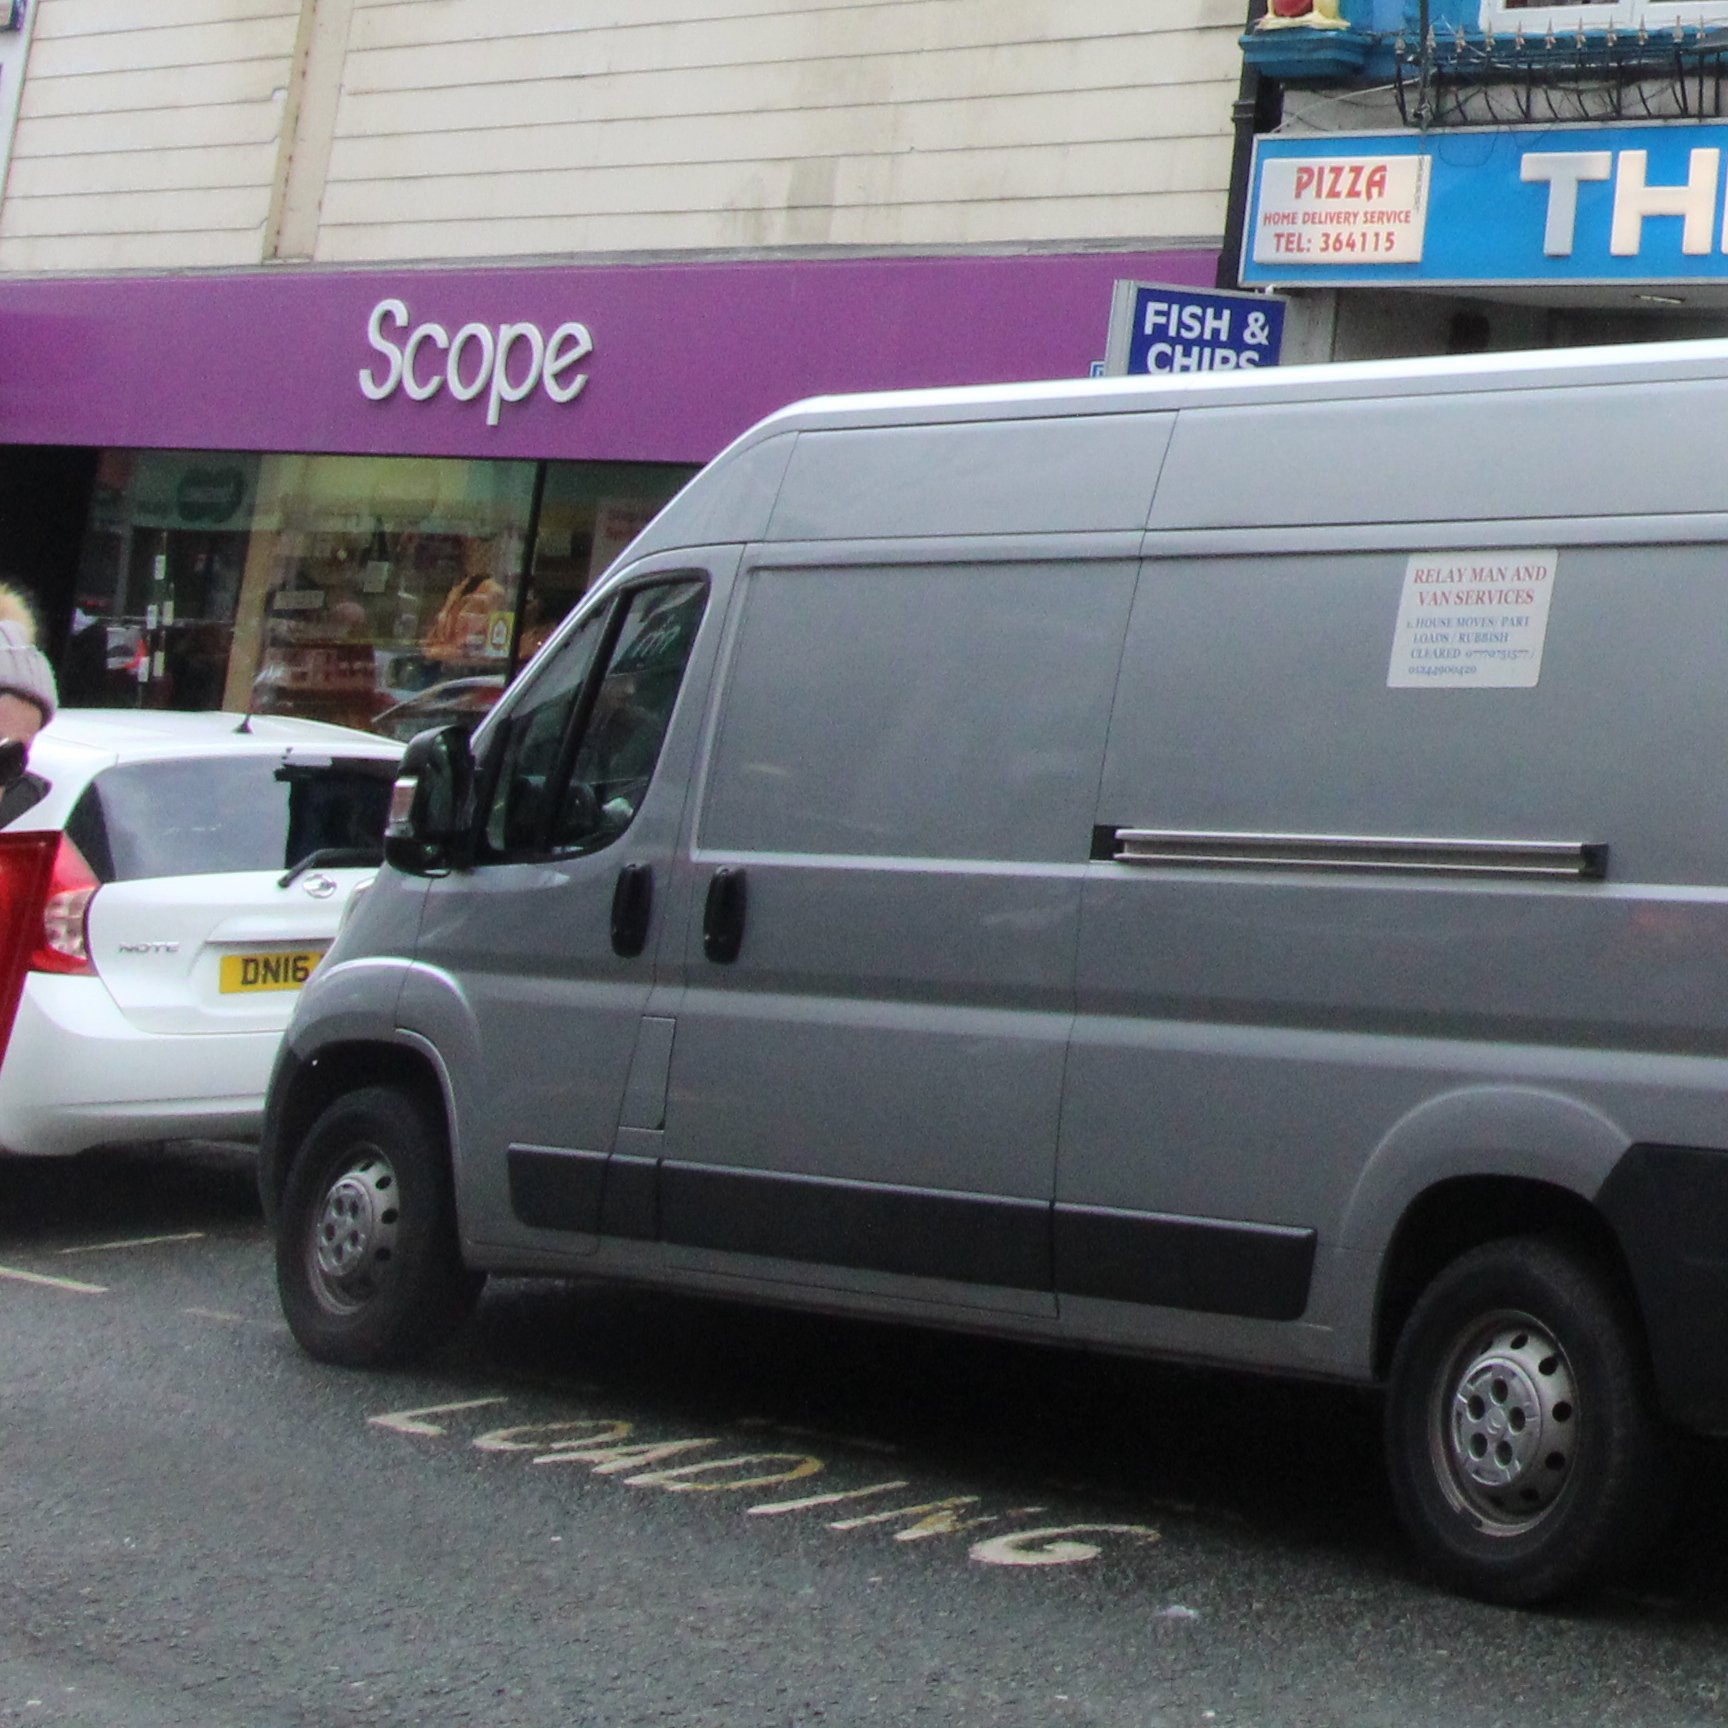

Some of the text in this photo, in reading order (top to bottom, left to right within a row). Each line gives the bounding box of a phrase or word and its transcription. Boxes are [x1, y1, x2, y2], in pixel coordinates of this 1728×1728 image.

[1294, 164, 1388, 203] PIZZA
[1263, 209, 1412, 226] HOME DELIVERY SERVICE
[1274, 231, 1396, 254] TEL: 364115
[1143, 301, 1270, 346] FISH &
[358, 298, 593, 426] Scope
[1413, 566, 1548, 584] RELAY MAN AND
[1418, 589, 1536, 606] VAN SERVICES
[1416, 617, 1452, 629] HOUSE
[1458, 632, 1510, 644] RUBBISH
[1411, 648, 1461, 660] CLEARED
[118, 941, 180, 954] NOTE
[240, 956, 311, 986] DN16
[366, 1396, 1160, 1566] LOADING
